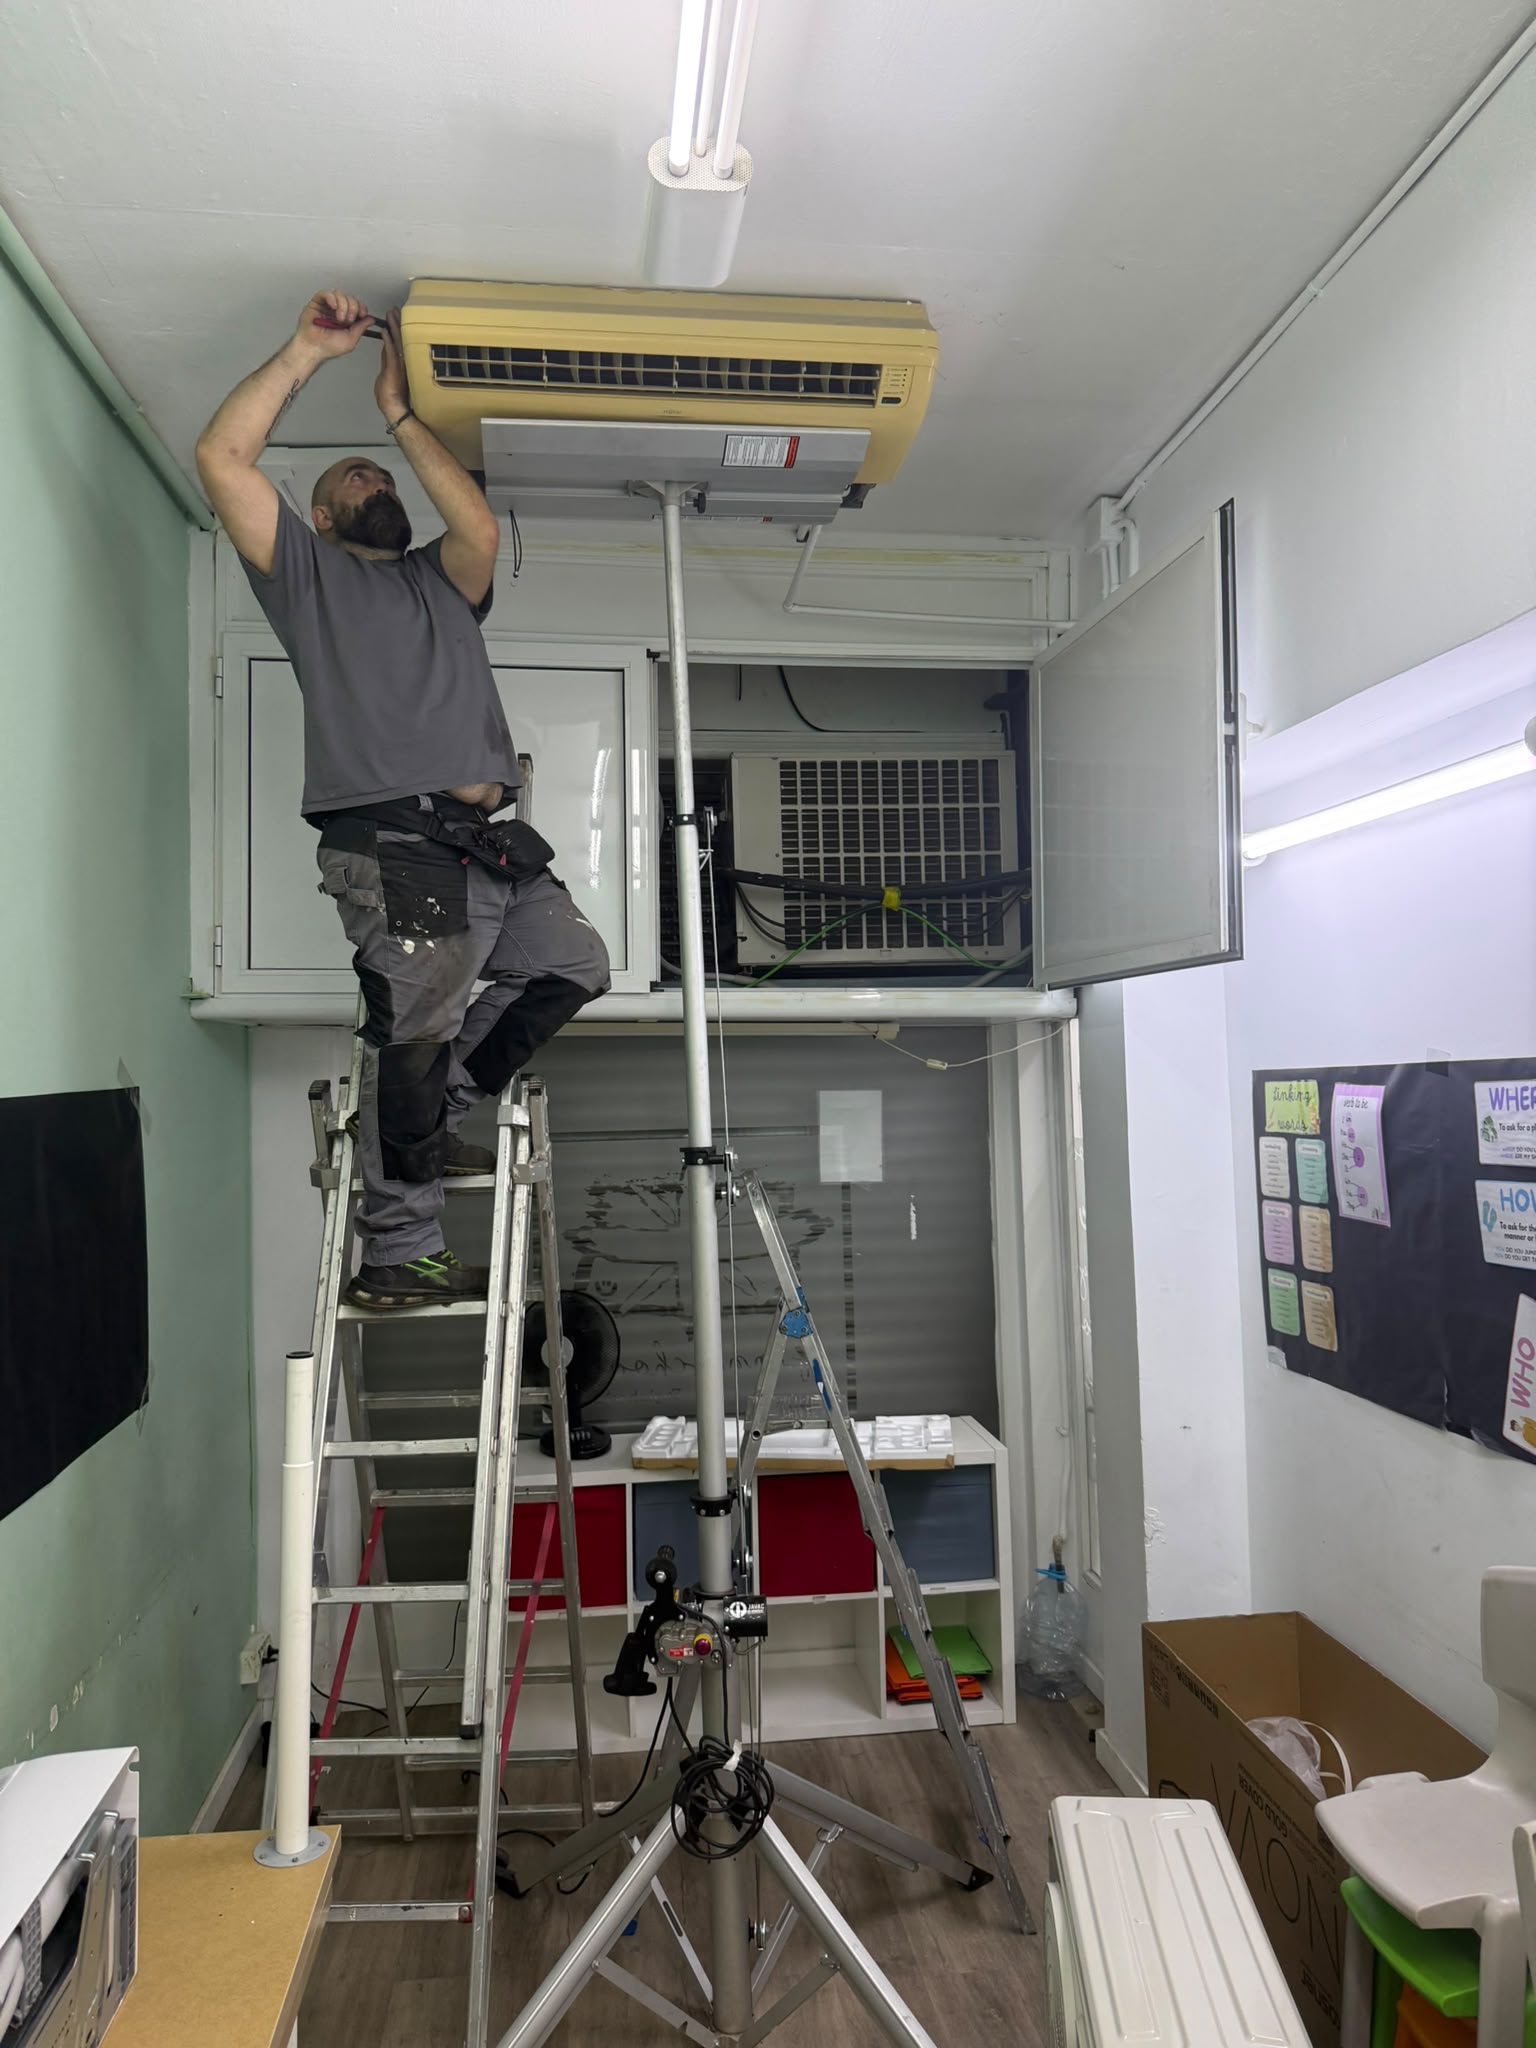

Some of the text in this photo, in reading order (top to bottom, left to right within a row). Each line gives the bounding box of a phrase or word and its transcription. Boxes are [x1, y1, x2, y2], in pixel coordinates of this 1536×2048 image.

[1499, 1123, 1505, 1131] To
[1507, 1123, 1516, 1131] ask
[1517, 1122, 1525, 1131] for
[1499, 1221, 1507, 1229] To
[1508, 1222, 1518, 1231] ask
[1518, 1222, 1528, 1232] for
[1510, 1336, 1536, 1409] WHO
